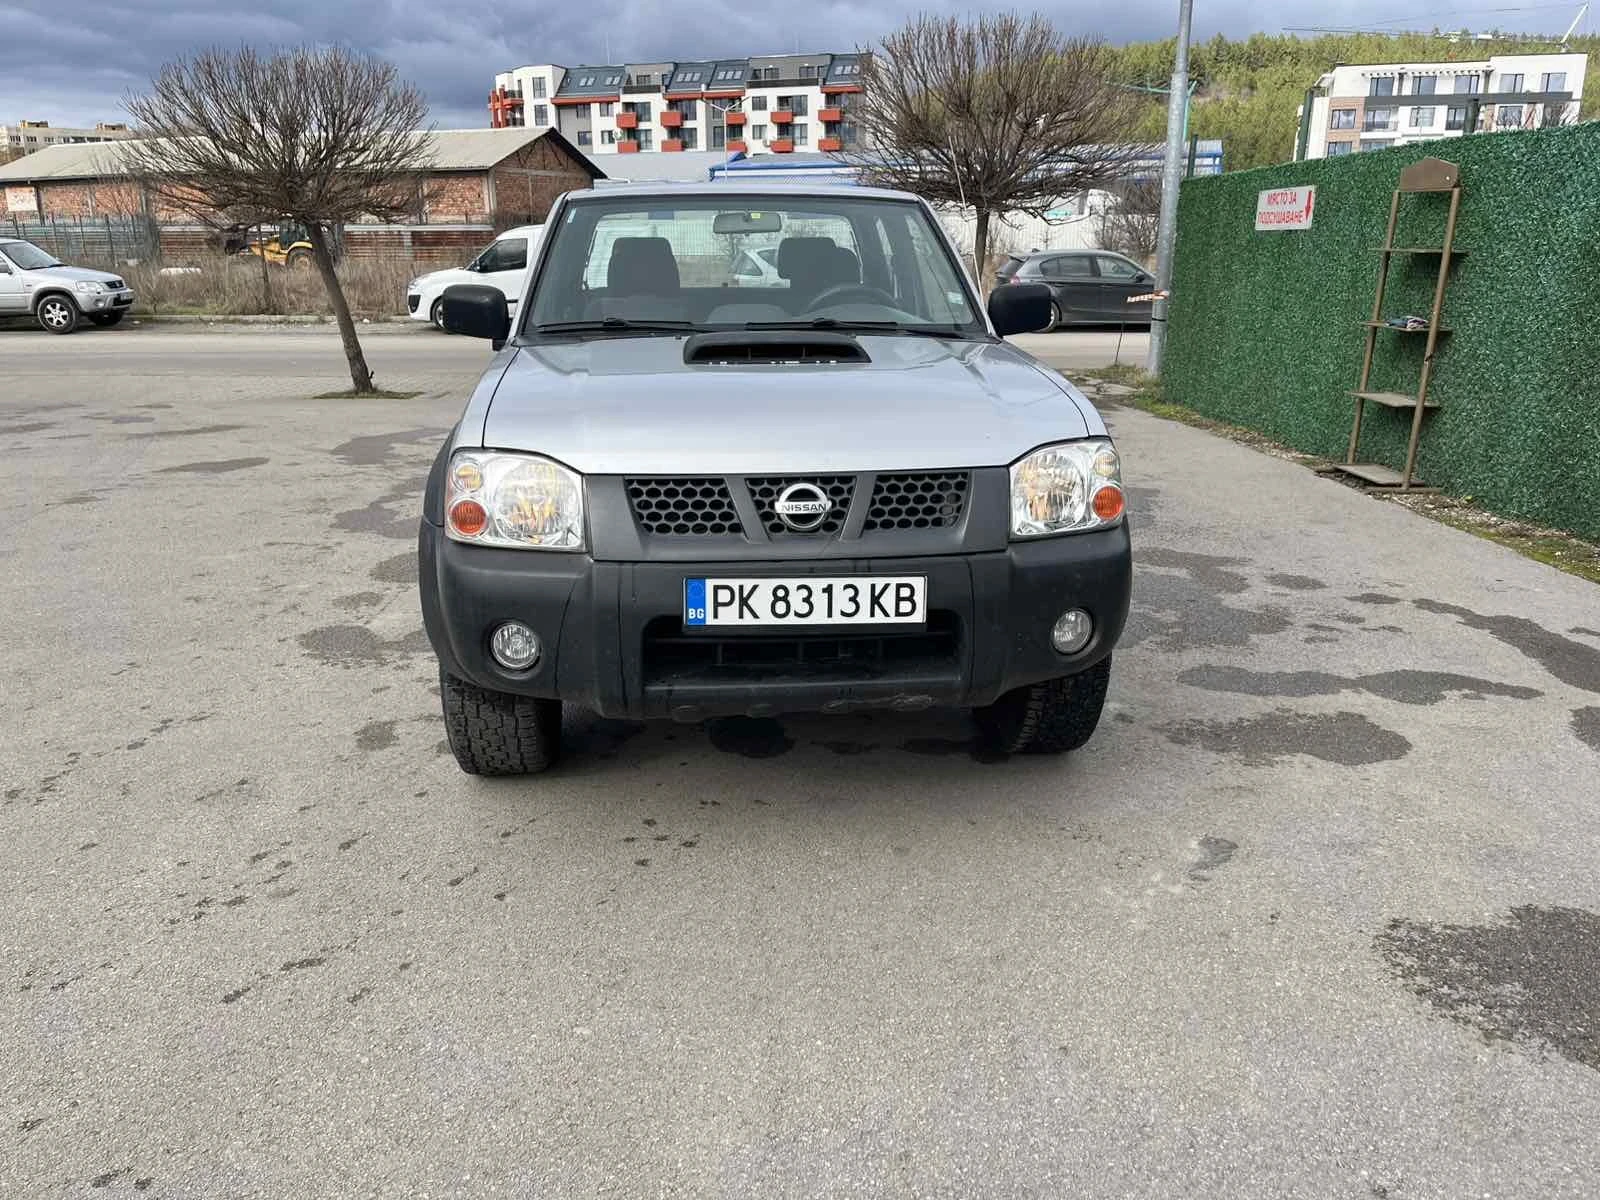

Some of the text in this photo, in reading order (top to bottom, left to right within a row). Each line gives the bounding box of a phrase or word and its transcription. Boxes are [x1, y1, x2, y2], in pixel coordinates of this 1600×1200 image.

[780, 503, 828, 512] NISSAN
[712, 583, 918, 619] PK 8313 KB
[688, 608, 705, 619] BG
